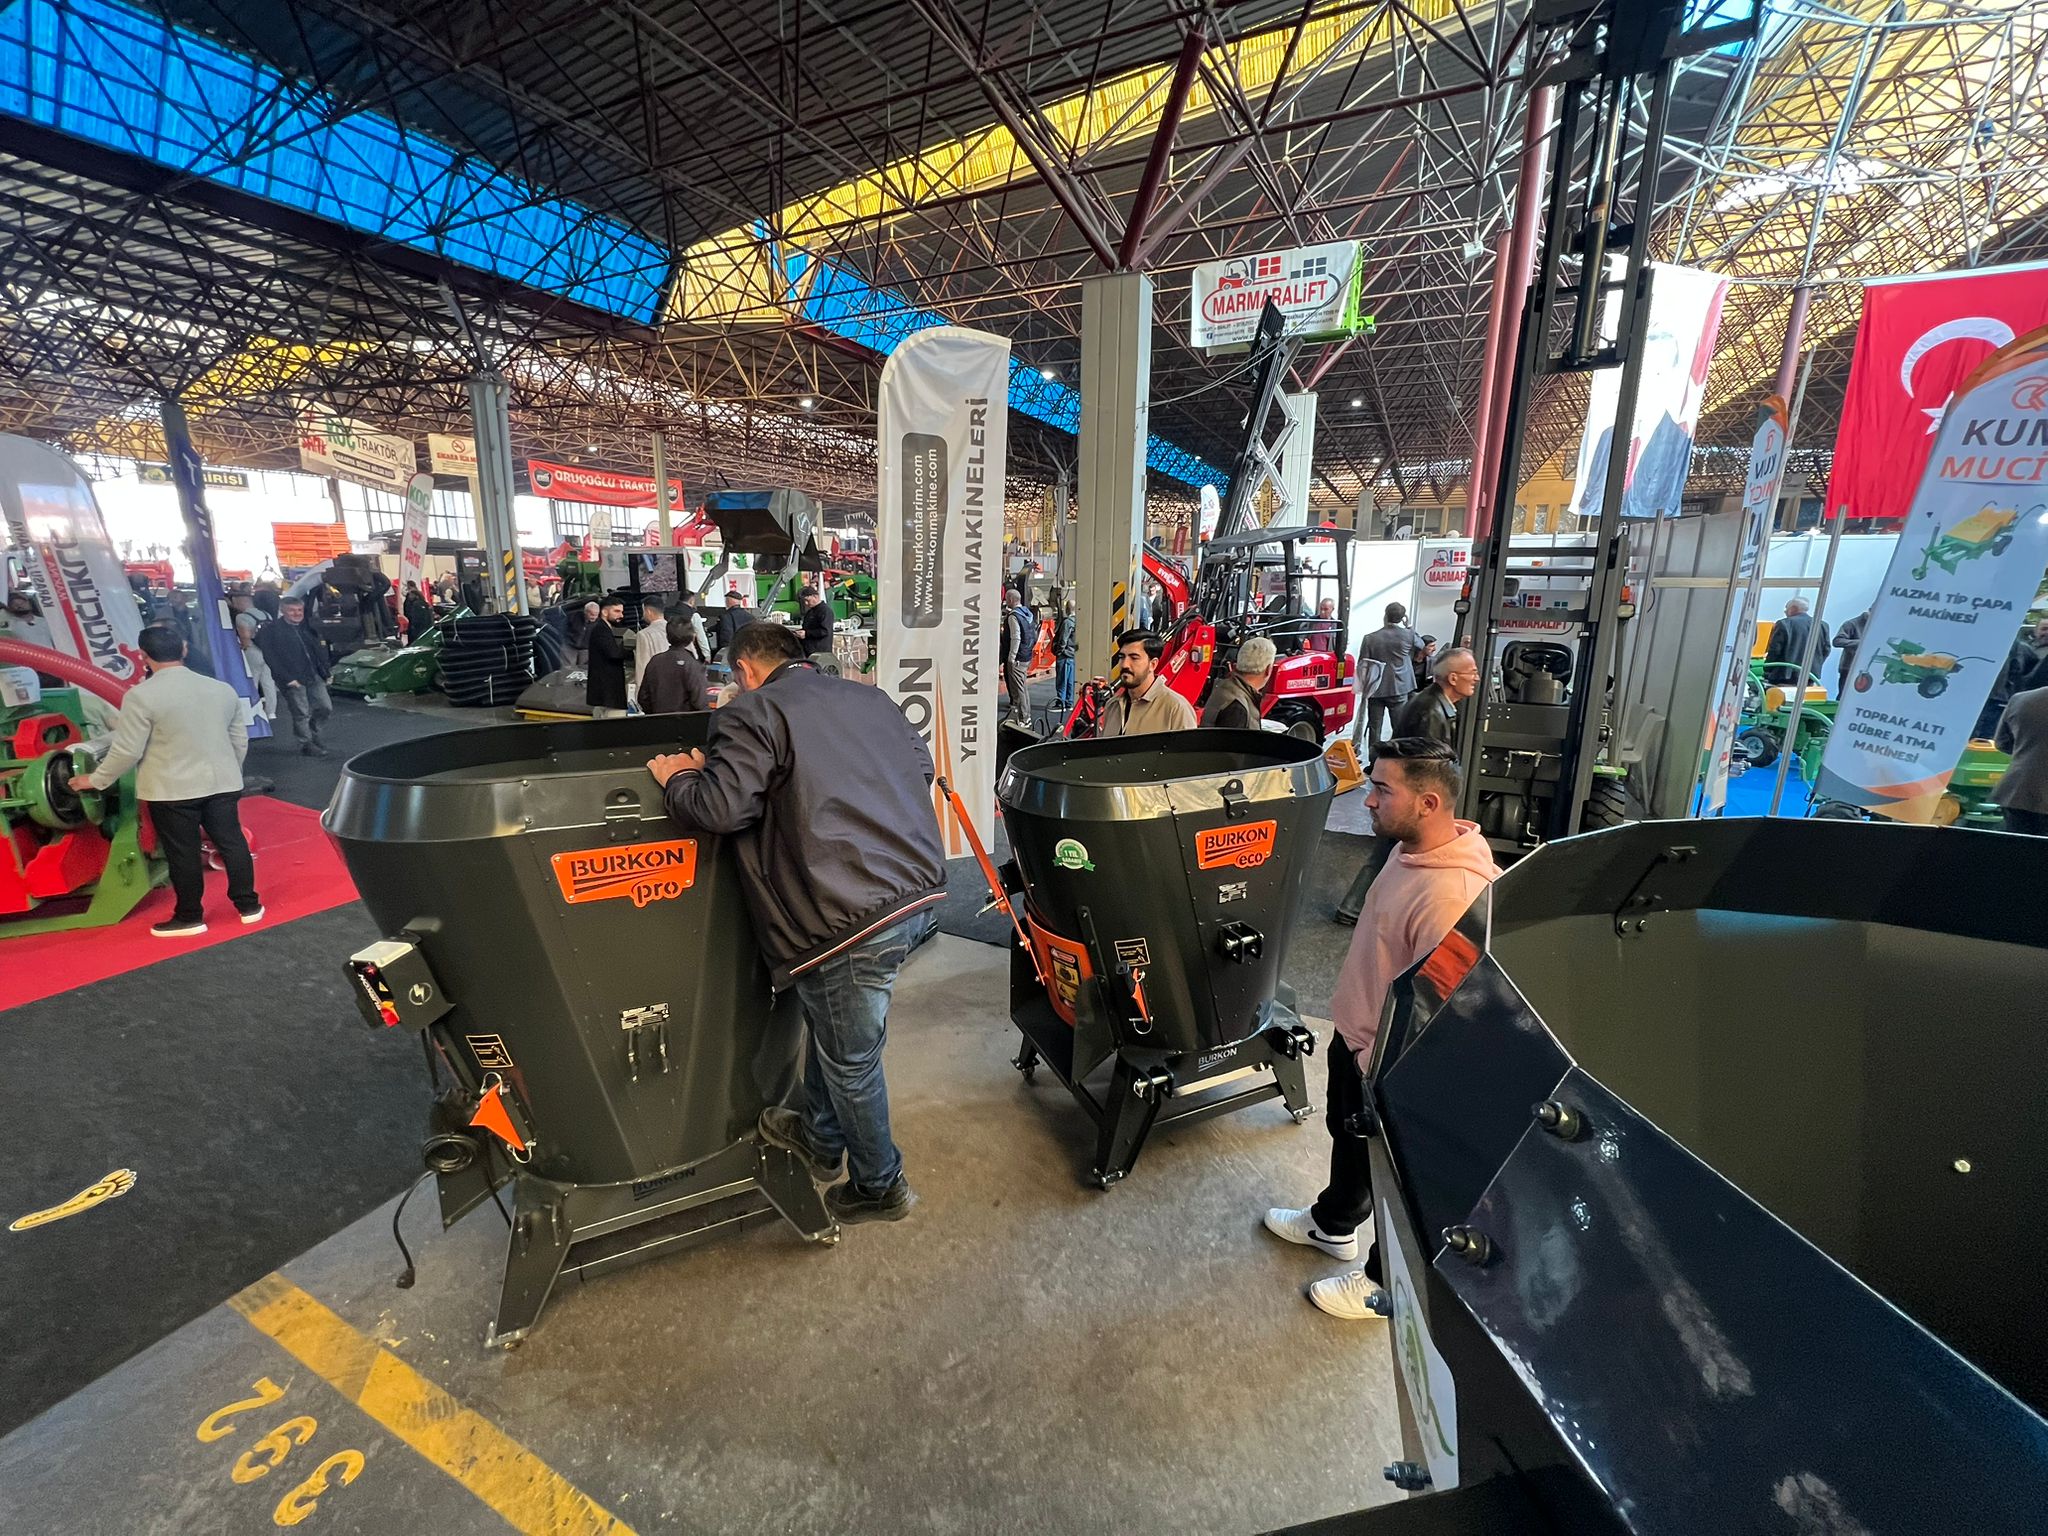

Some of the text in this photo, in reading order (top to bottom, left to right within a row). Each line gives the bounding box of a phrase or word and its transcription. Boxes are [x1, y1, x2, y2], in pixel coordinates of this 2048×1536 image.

[356, 436, 399, 462] TRAKTÖR
[912, 454, 923, 609] www.burkontarim.com
[924, 448, 937, 615] www.burkonmakine.com
[961, 397, 988, 763] YEM KARMA MAKİNELERİ
[1890, 586, 2013, 612] KAZMA TİP ÇAPA
[1908, 606, 1980, 625] MAKİNESİ
[1855, 707, 1945, 736] TOPRAK ALTI
[1848, 722, 1936, 751] GÜBRE ATMA
[1853, 739, 1920, 764] MAKİNESİ
[1204, 827, 1268, 850] BURKON
[570, 847, 684, 878] BURKON
[1240, 852, 1263, 865] eco
[637, 881, 679, 904] pro
[1198, 1047, 1238, 1065] BURKON
